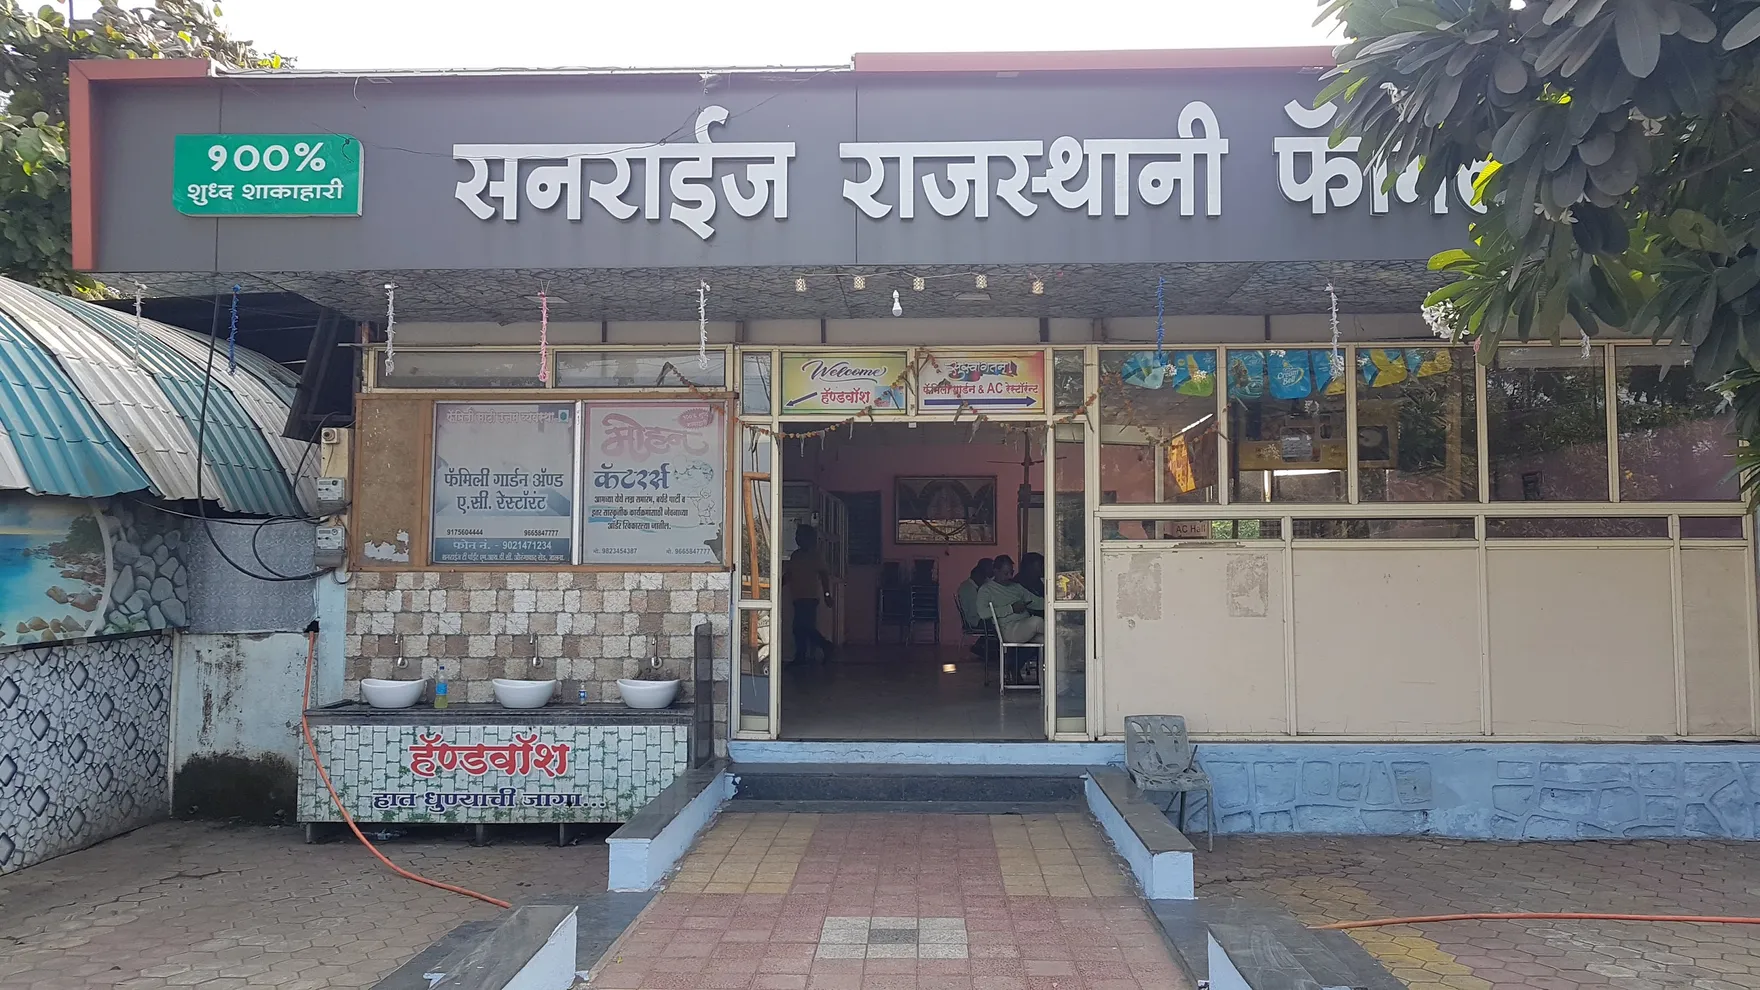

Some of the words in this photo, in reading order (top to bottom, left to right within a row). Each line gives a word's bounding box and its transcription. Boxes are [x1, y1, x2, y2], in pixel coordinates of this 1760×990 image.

[452, 105, 796, 241] सनराईज
[840, 101, 1229, 219] राजस्थानी
[241, 178, 345, 202] शाकाहारी
[802, 359, 888, 382] Welcome
[821, 387, 871, 404] हॅण्डवॉश
[978, 384, 985, 394] &
[986, 382, 1003, 394] AC
[444, 467, 490, 487] फॅमिली
[494, 468, 529, 487] गार्डन
[456, 490, 492, 514] ए.सी.
[1175, 524, 1188, 534] AC
[452, 539, 476, 550] फोन
[502, 540, 552, 550] 9021471234
[409, 733, 570, 779] हॅण्डवॉश
[372, 791, 417, 810] हात
[424, 787, 516, 813] धुण्याची
